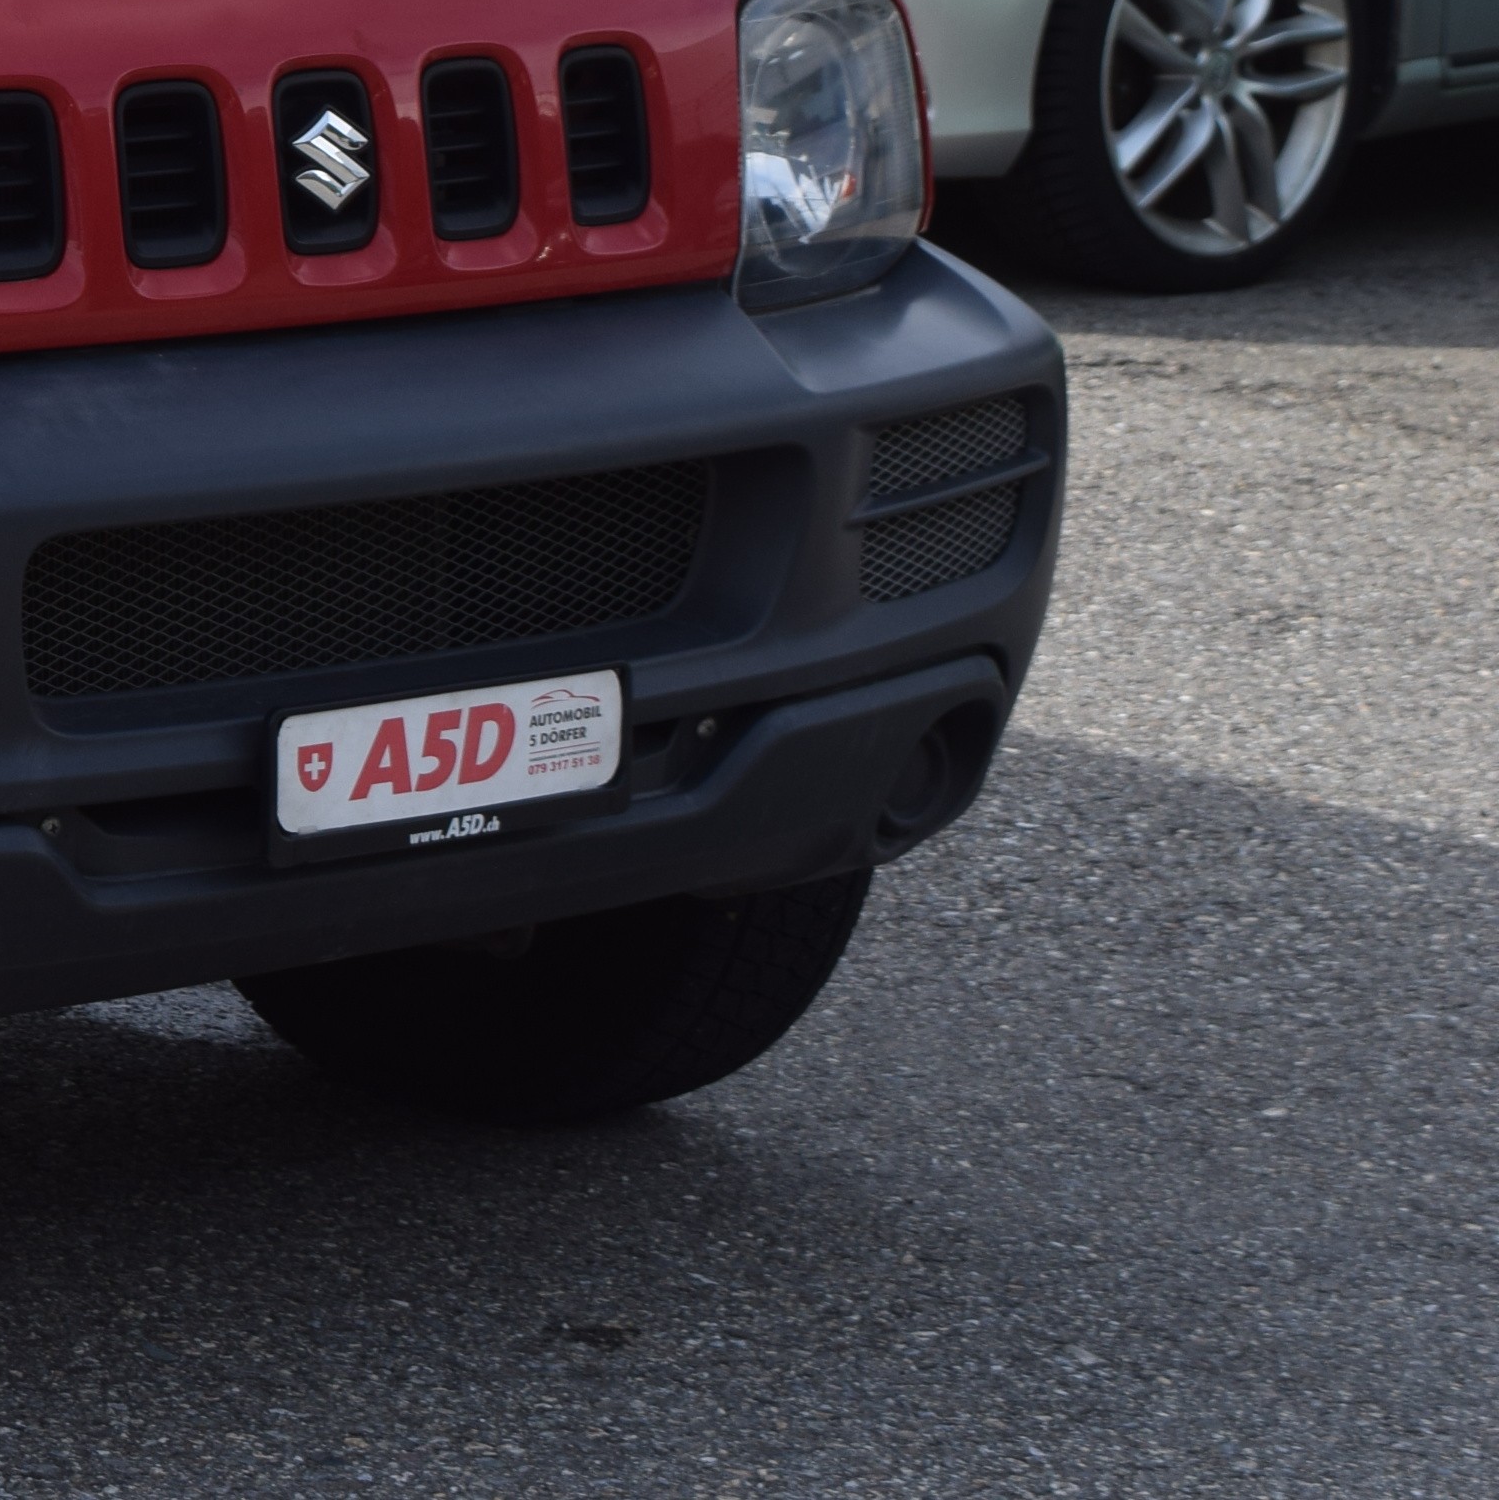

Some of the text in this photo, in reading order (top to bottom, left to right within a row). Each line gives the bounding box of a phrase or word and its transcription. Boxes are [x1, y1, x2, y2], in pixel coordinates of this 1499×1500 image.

[529, 706, 602, 728] AUTOMOBIL
[529, 726, 587, 747] 5 DÖRFER
[349, 703, 516, 801] A5D
[528, 762, 547, 776] 079
[550, 759, 569, 772] 317
[571, 757, 584, 768] 51
[409, 813, 501, 845] www.A5D.ch
